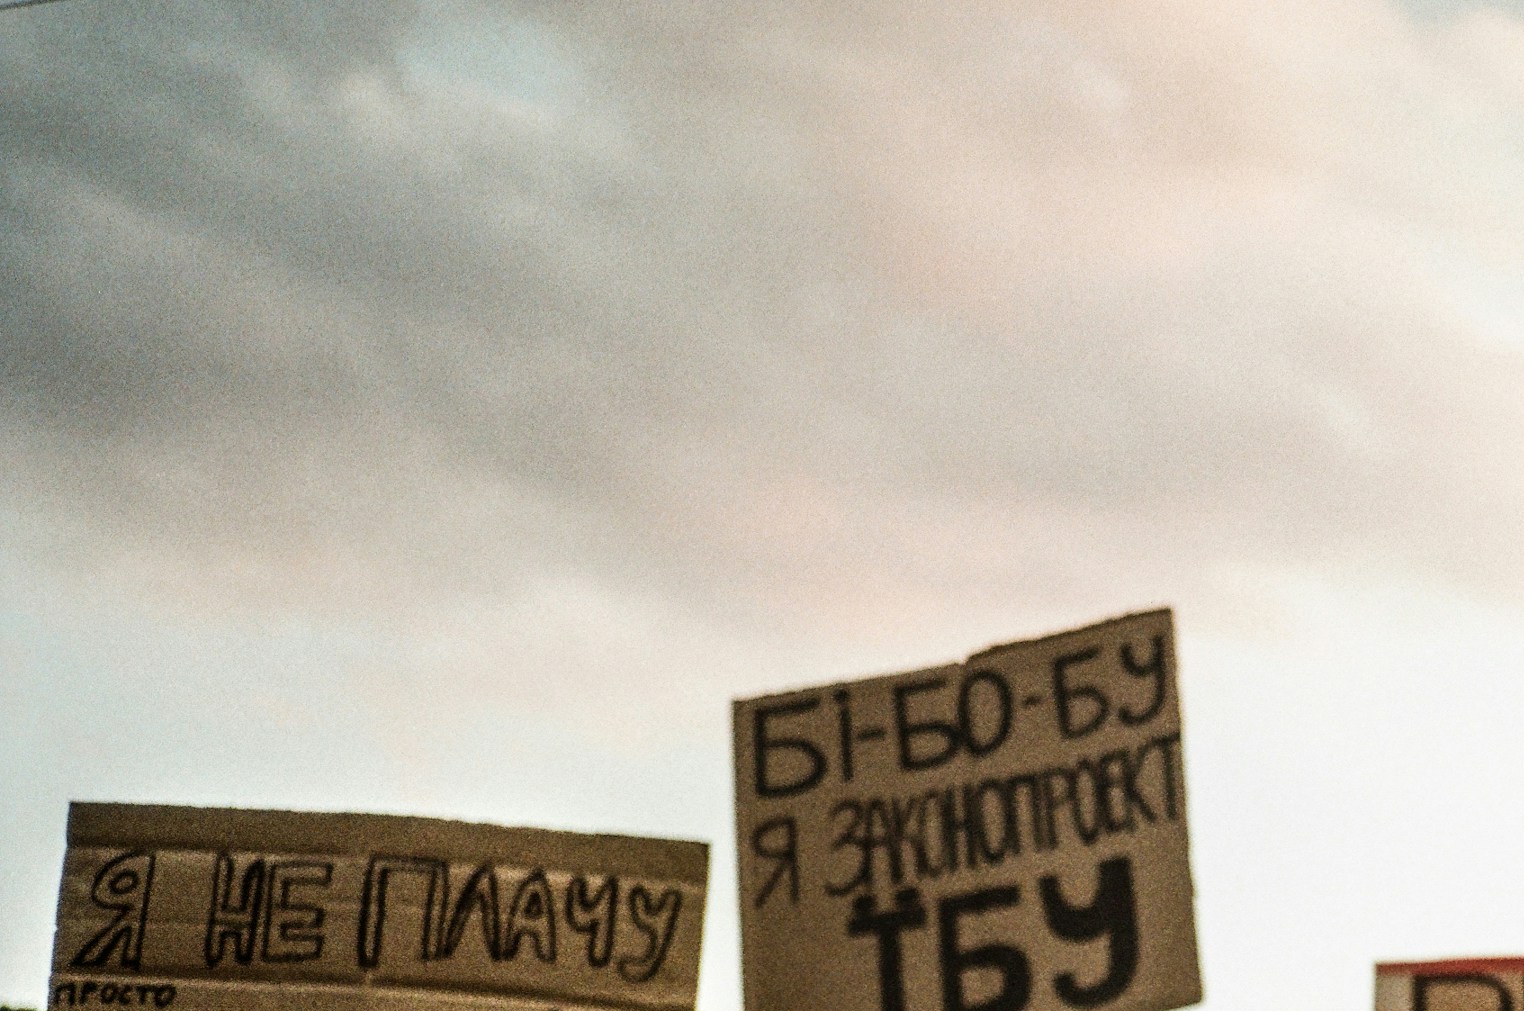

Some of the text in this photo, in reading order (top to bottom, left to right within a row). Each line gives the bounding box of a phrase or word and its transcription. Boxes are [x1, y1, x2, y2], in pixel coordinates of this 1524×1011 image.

[750, 816, 802, 910] Я
[69, 850, 684, 983] Я НЕ ПЛАЧУ
[52, 980, 177, 1010] ПРОСТО
